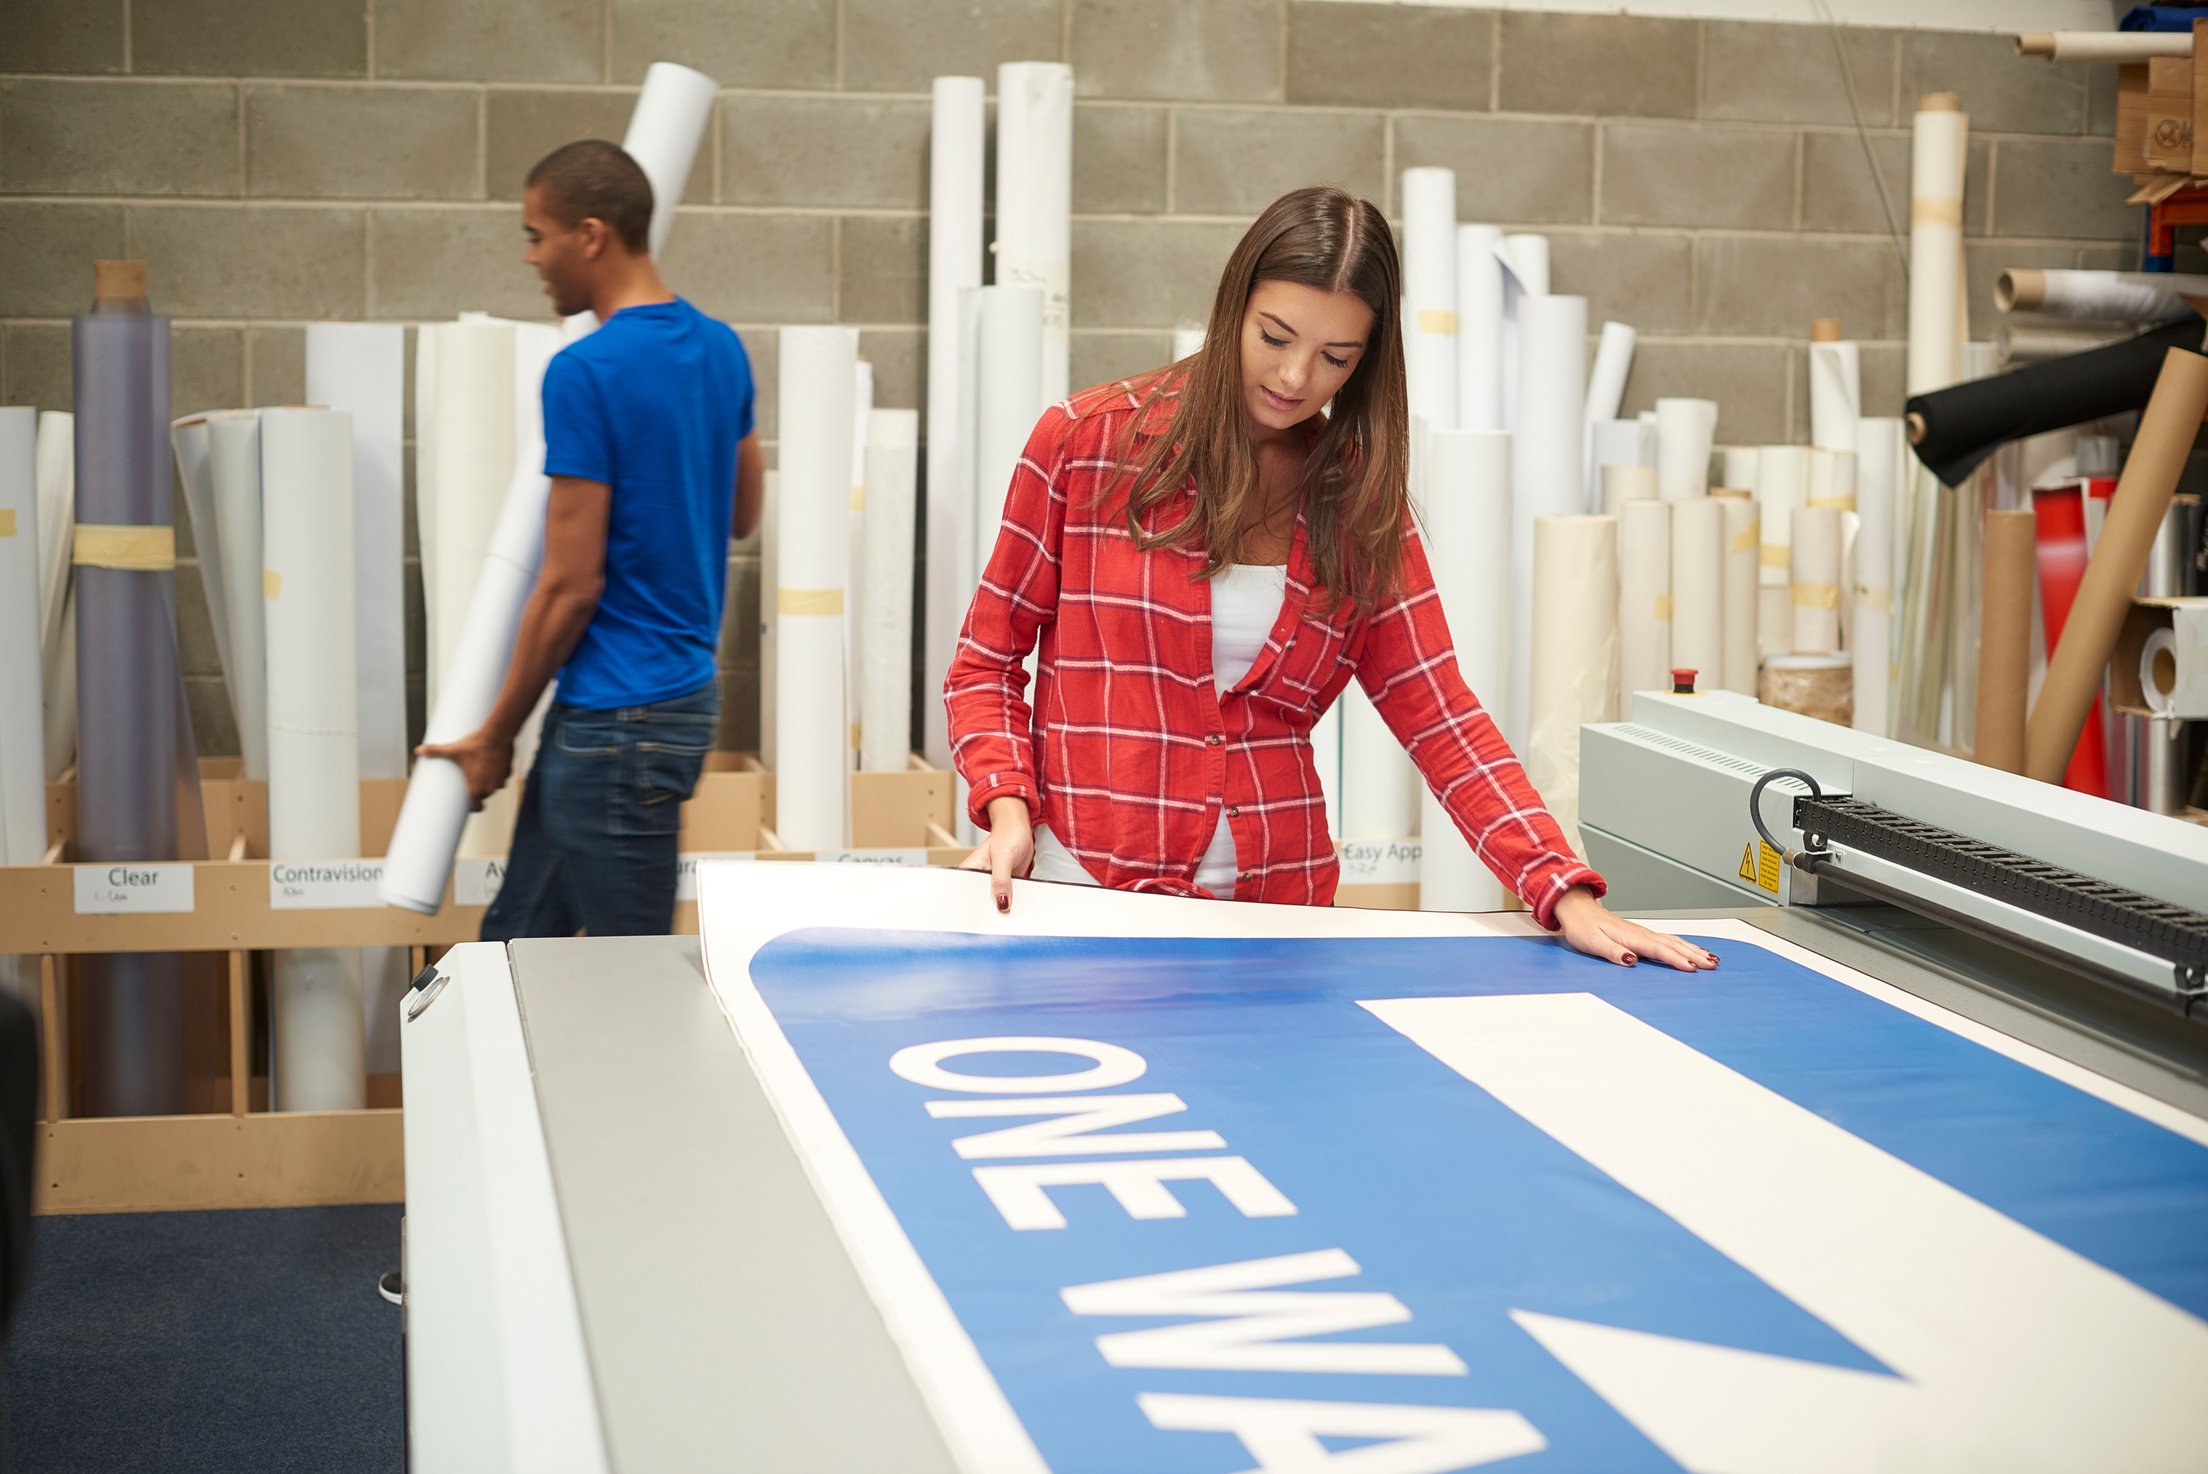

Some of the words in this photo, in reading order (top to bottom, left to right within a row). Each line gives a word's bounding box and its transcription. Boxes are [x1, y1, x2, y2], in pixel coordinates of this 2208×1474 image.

[1344, 843, 1383, 863] Easy
[108, 867, 159, 887] Clear
[273, 863, 384, 884] Contravision
[889, 1036, 1299, 1231] ONE
